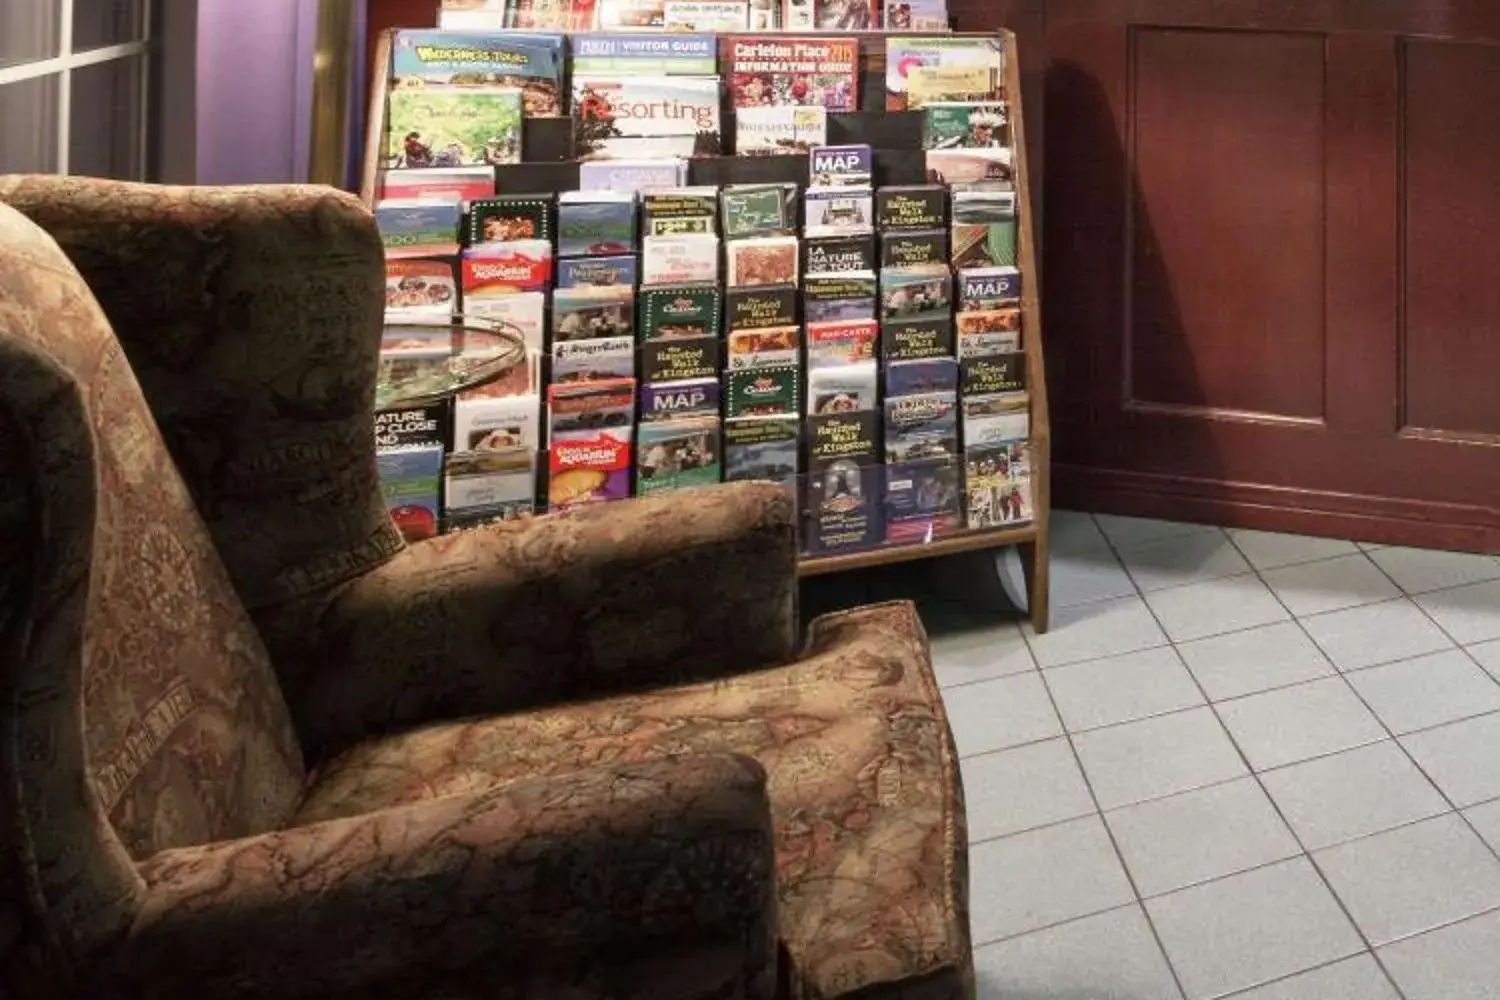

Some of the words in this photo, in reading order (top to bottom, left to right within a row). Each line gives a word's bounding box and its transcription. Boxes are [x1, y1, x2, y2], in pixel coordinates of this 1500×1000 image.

[622, 41, 669, 51] VISITOR
[671, 41, 708, 51] GUIDE
[735, 43, 791, 57] Carleton
[794, 43, 829, 57] Place
[734, 61, 816, 73] INFORMATION
[815, 155, 861, 172] MAP
[808, 251, 862, 263] NATURE
[966, 281, 1010, 297] MAP
[653, 391, 706, 411] MAP
[387, 419, 438, 433] CLOSE
